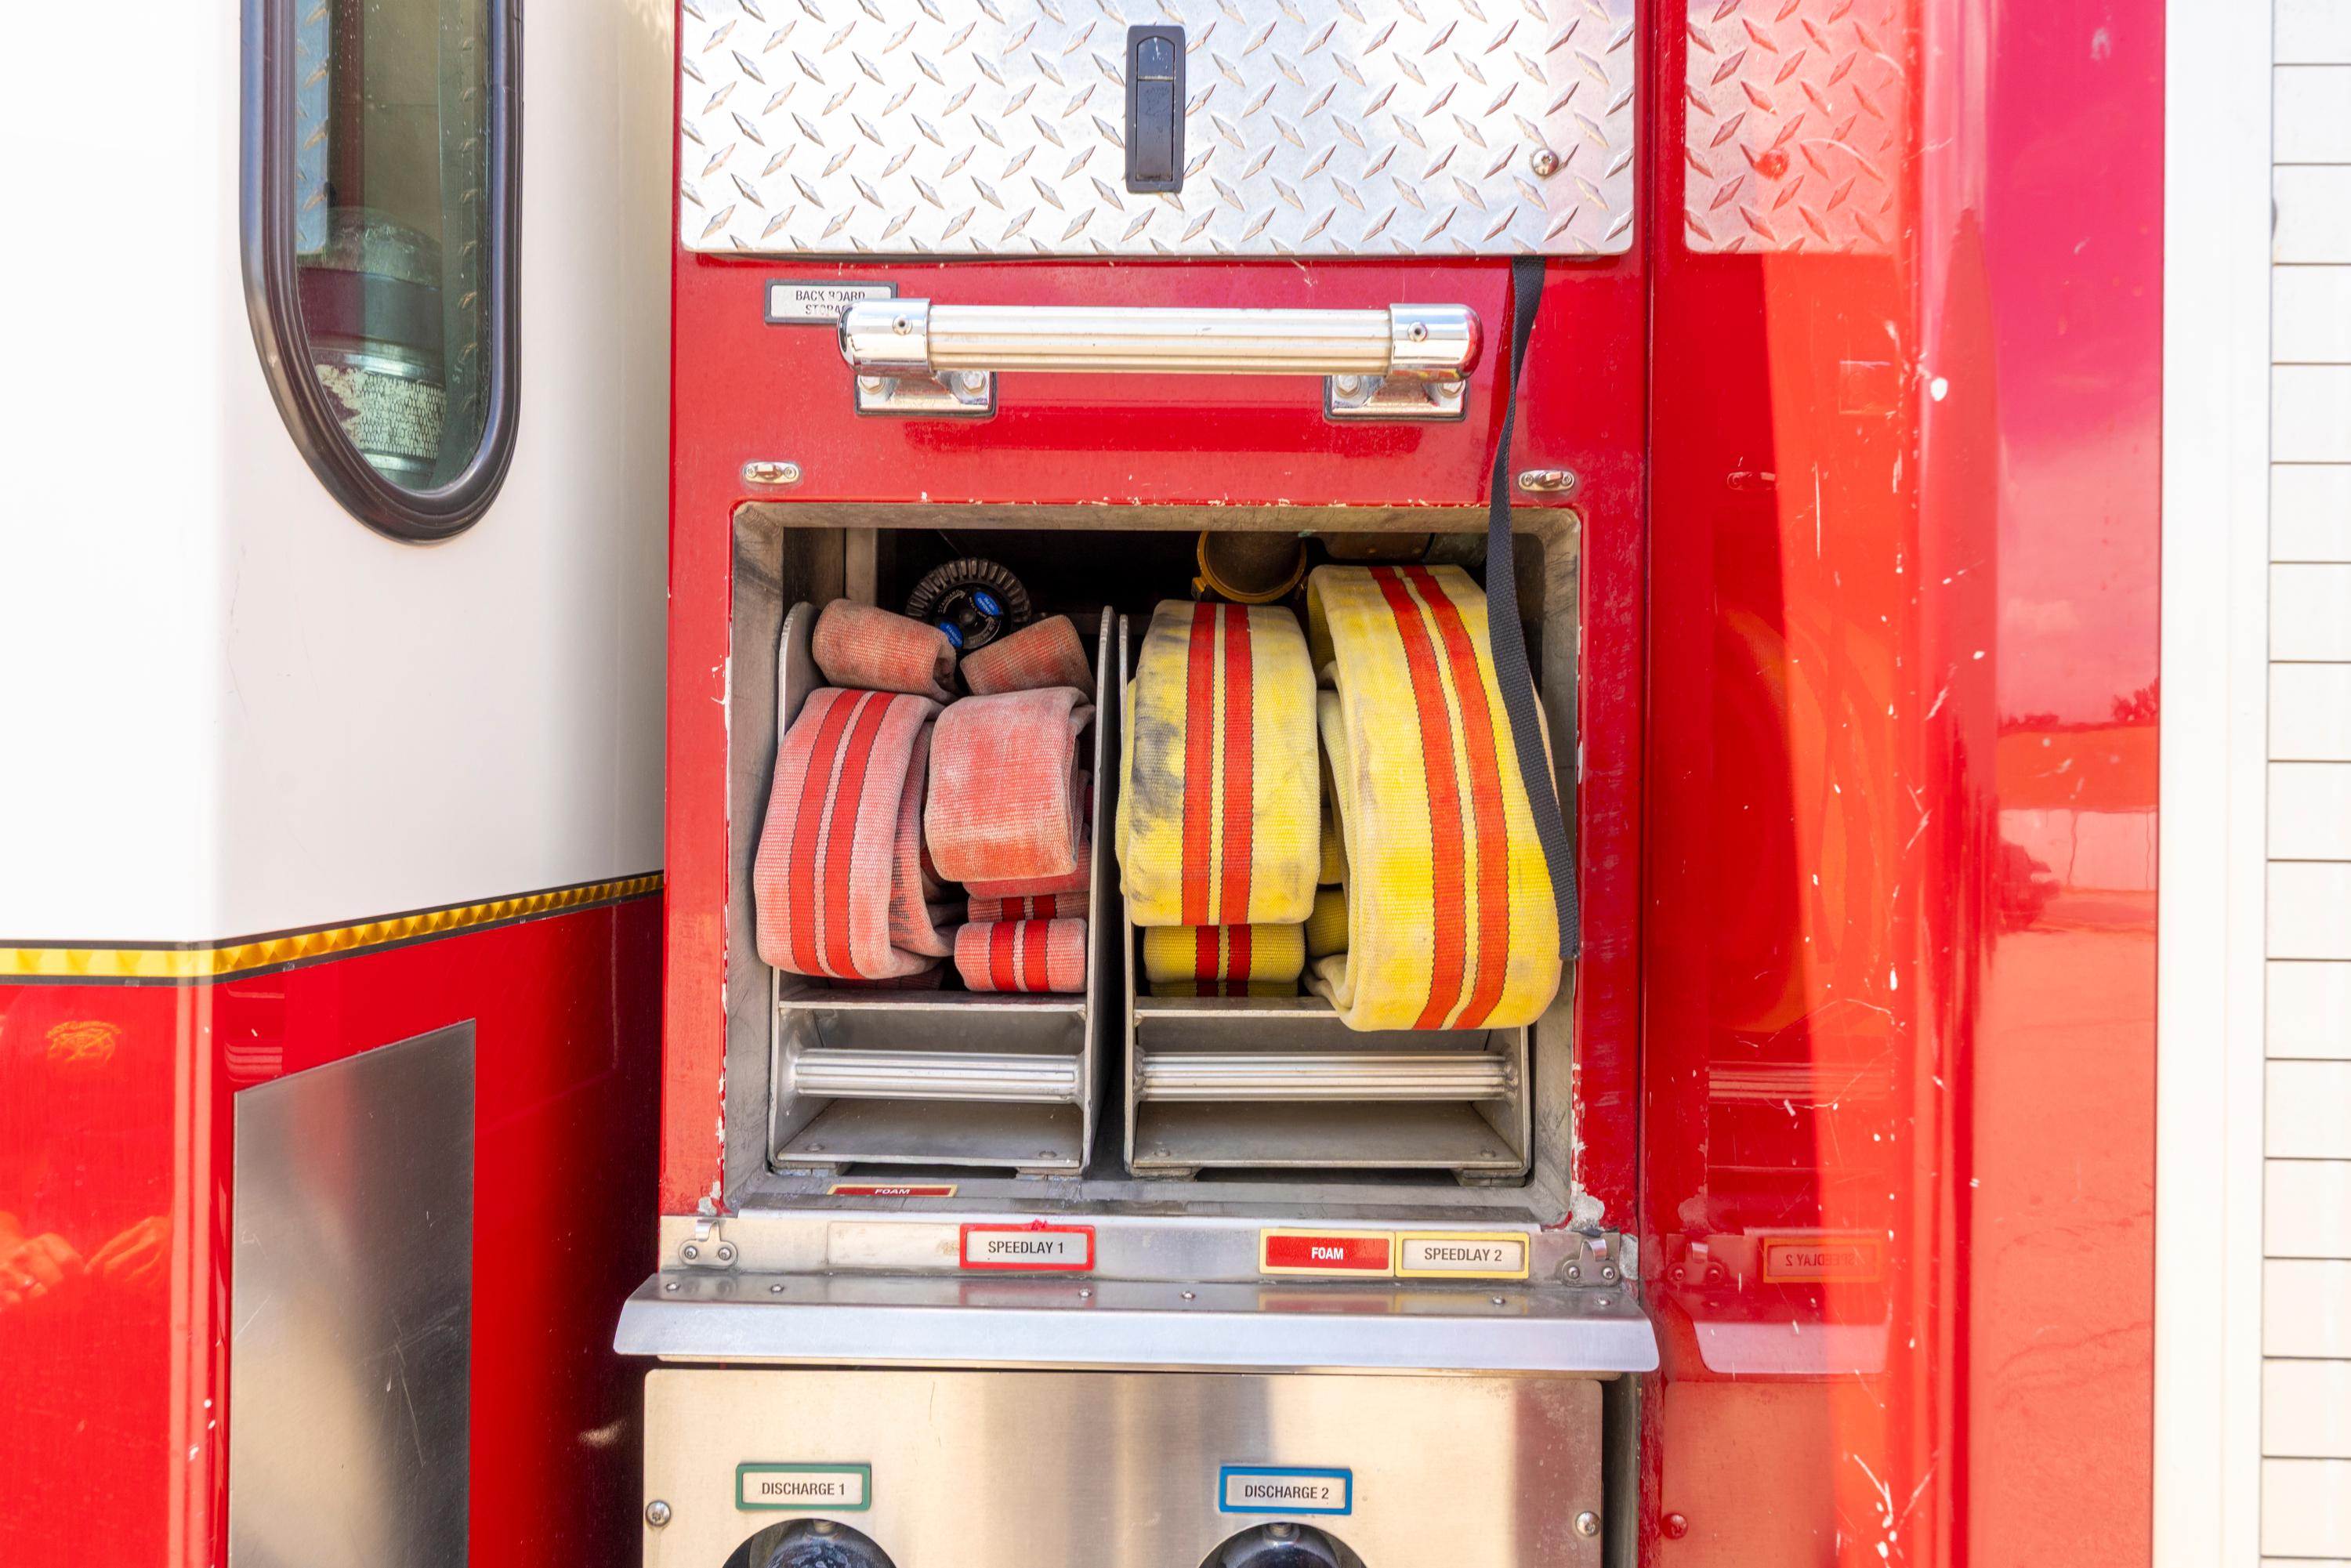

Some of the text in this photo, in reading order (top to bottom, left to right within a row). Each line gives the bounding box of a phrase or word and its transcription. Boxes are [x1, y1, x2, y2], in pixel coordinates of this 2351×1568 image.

[795, 290, 824, 301] BACK
[806, 304, 846, 315] STORA
[987, 1240, 1064, 1254] SPEEDLAY 1
[1311, 1247, 1344, 1260] FOAM
[1424, 1247, 1502, 1262] SPEEDLAY 2
[761, 1482, 845, 1495] DISCHARGE 1
[1244, 1485, 1329, 1499] DISCHARGE 2
